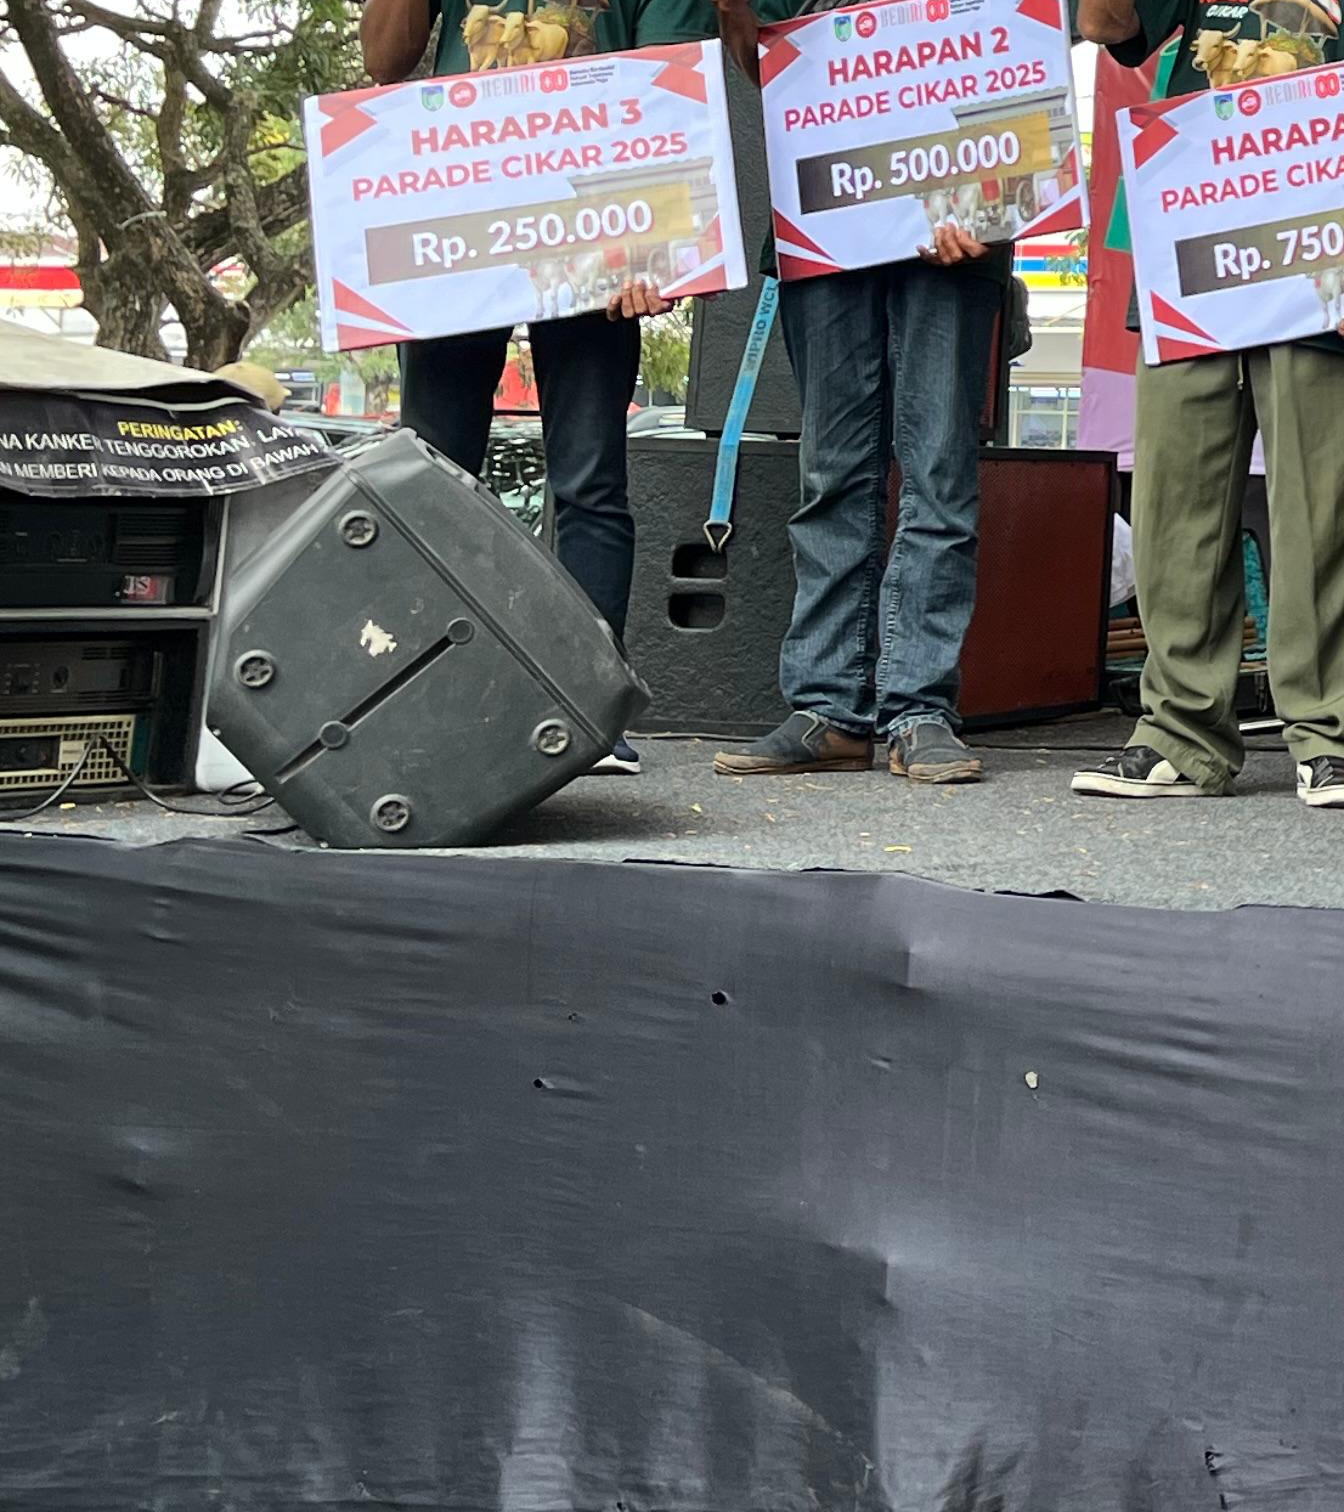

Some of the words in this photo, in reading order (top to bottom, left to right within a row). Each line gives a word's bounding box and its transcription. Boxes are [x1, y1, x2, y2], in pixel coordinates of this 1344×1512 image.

[828, 32, 982, 86] HARAPAN
[990, 26, 1010, 54] 2
[784, 89, 891, 132] PARADE
[897, 72, 978, 110] CIKAR
[985, 60, 1047, 93] 2025
[411, 102, 609, 157] HARAPAN
[617, 98, 643, 126] 3
[352, 159, 492, 202] PARADE
[501, 143, 602, 180] CIKAR
[611, 132, 688, 163] 2025
[831, 163, 882, 199] Rp.
[890, 130, 1020, 186] 500.000
[1161, 169, 1279, 213] PARADE
[413, 229, 478, 269] Rp.
[487, 199, 653, 256] 250.000
[1213, 242, 1272, 281] Rp.
[117, 419, 243, 441] PERINGATAN:
[14, 463, 98, 480] MEMBERI
[101, 463, 162, 482] KEPADA
[162, 465, 225, 482] ORANG
[226, 462, 249, 476] DI
[250, 443, 319, 470] BAWAH
